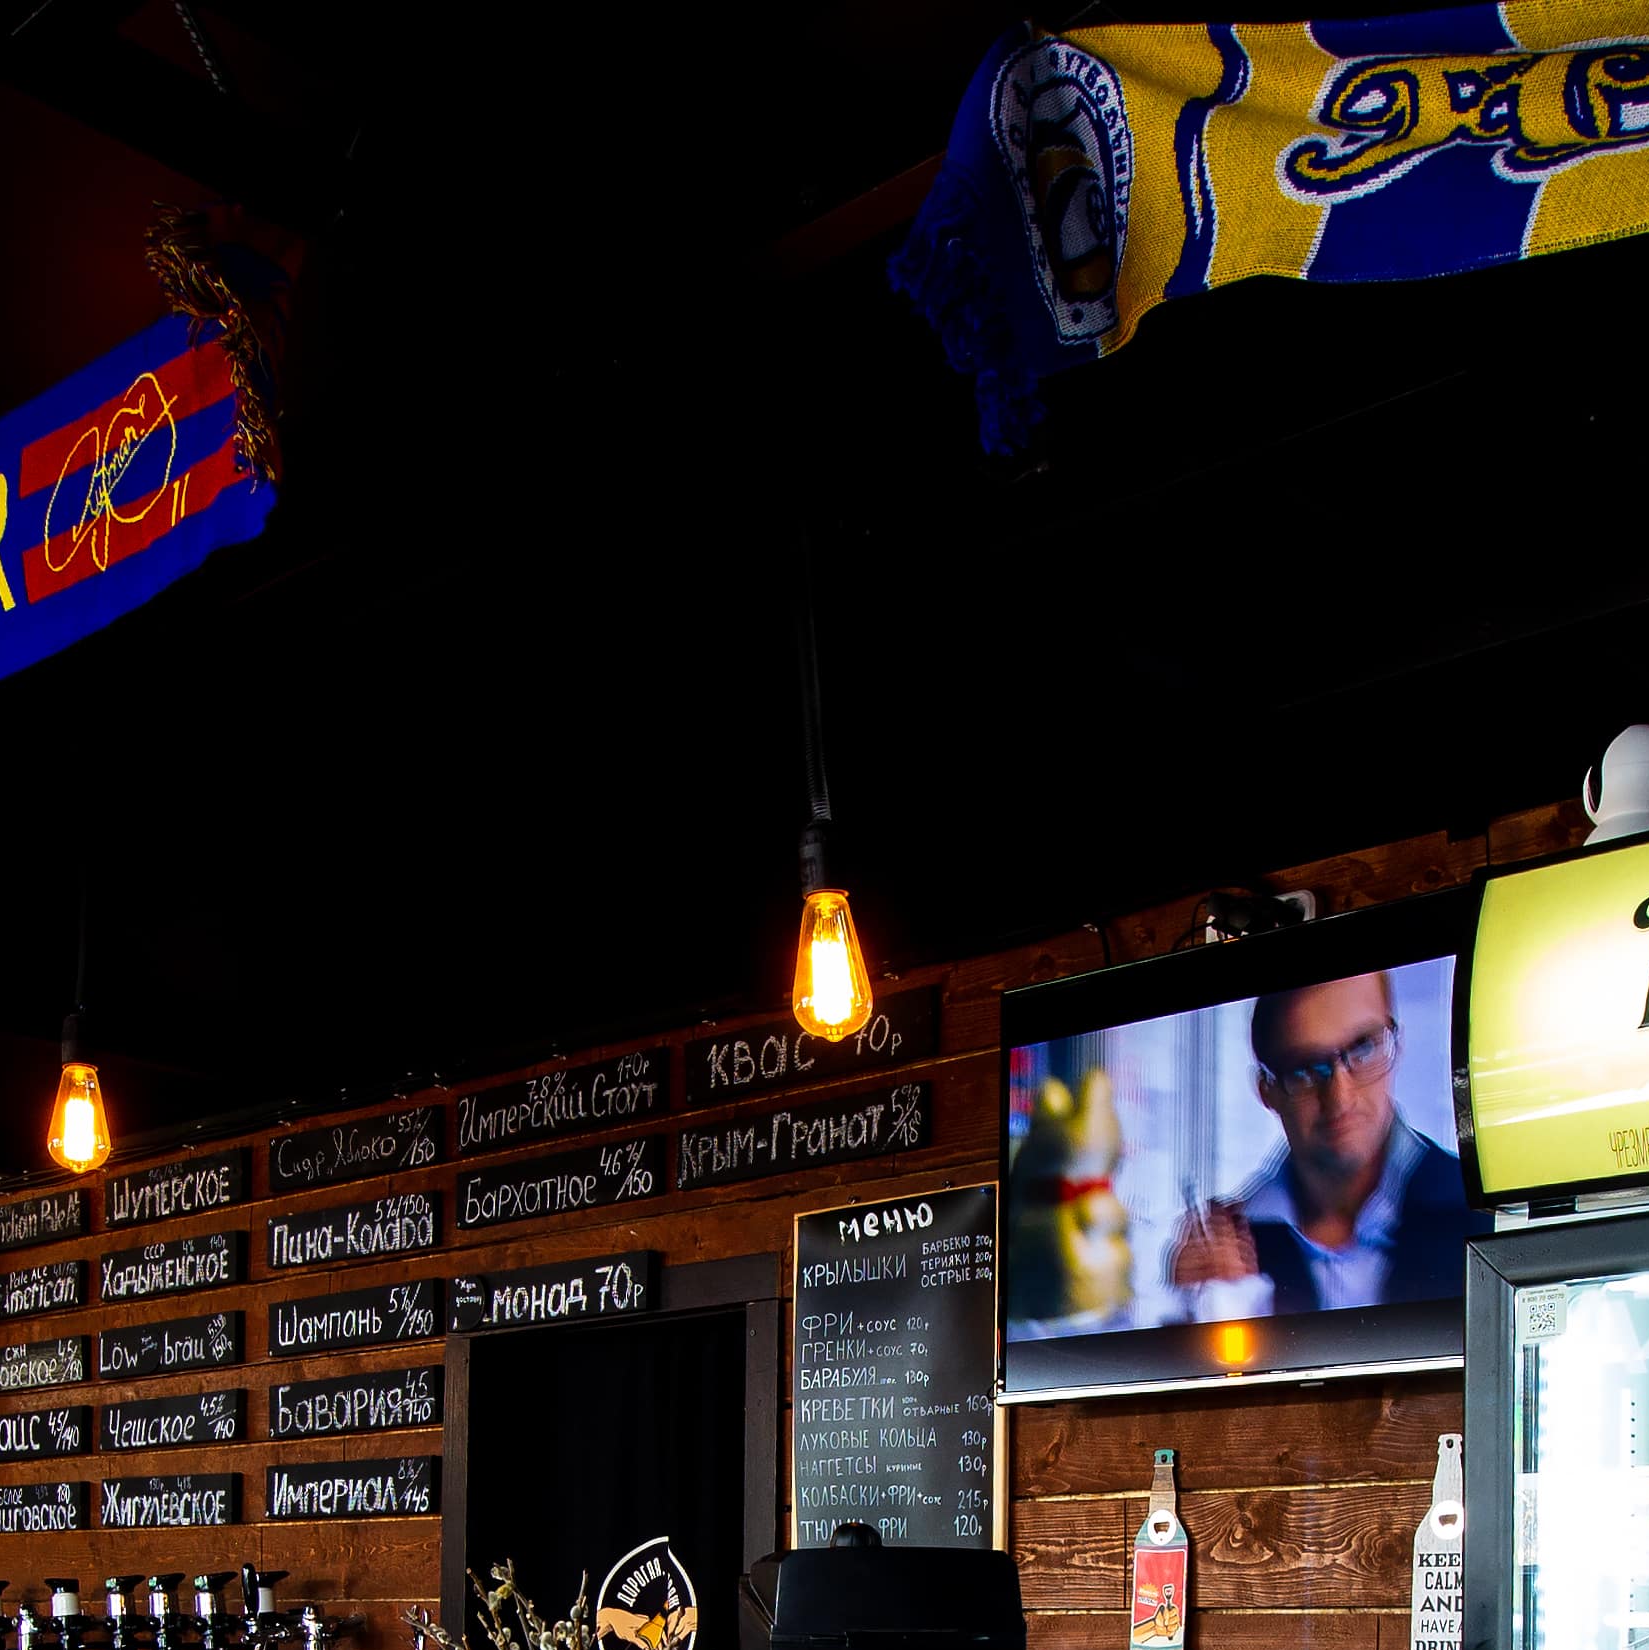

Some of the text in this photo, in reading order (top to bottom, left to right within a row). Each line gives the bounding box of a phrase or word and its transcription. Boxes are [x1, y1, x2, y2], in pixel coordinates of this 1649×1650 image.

[921, 1234, 972, 1256] БАРБЕКЮ
[802, 1253, 908, 1290] КРЫЛЫШКИ
[920, 1253, 971, 1273] ТЕРИЯКИ
[921, 1267, 972, 1289] ОСТРЫЕ
[277, 1305, 383, 1347] Шампань
[801, 1311, 854, 1340] ФРИ
[801, 1339, 866, 1365] ГРЕНКИ
[800, 1365, 877, 1391] БАРАБУЛЯ
[801, 1395, 896, 1425] КРЕВЕТКИ
[902, 1403, 961, 1418] ОТВАРНЫЕ
[800, 1429, 871, 1452] ЛУКОВЫЕ
[878, 1426, 938, 1449] КОЛЬЦА
[800, 1455, 878, 1478] НАГГЕТСЫ
[878, 1516, 909, 1542] ФРИ
[1420, 1618, 1455, 1634] HAVE
